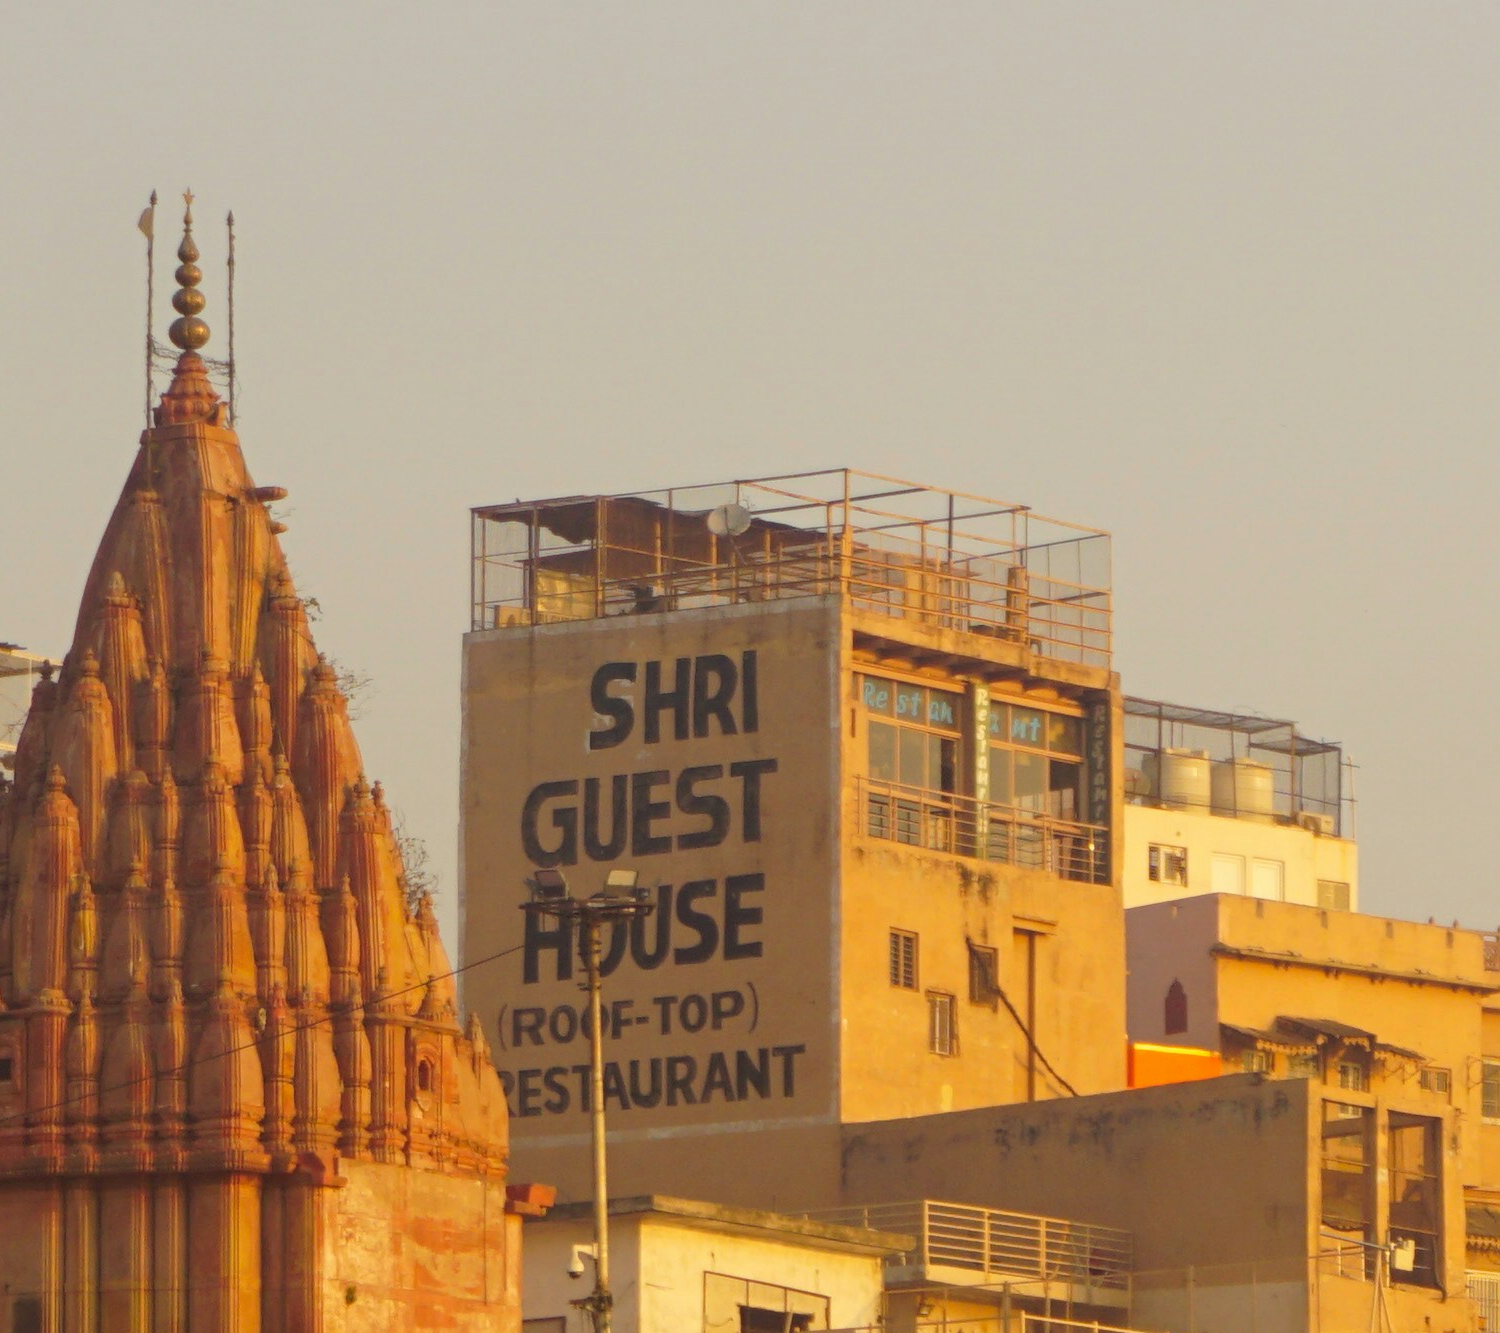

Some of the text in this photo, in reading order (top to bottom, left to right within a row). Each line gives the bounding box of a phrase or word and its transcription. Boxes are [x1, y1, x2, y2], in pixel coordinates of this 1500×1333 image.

[589, 650, 760, 750] SHRI
[521, 758, 779, 868] GUEST
[521, 873, 766, 984] HOUSE
[499, 981, 760, 1050] (ROOF-TOP)
